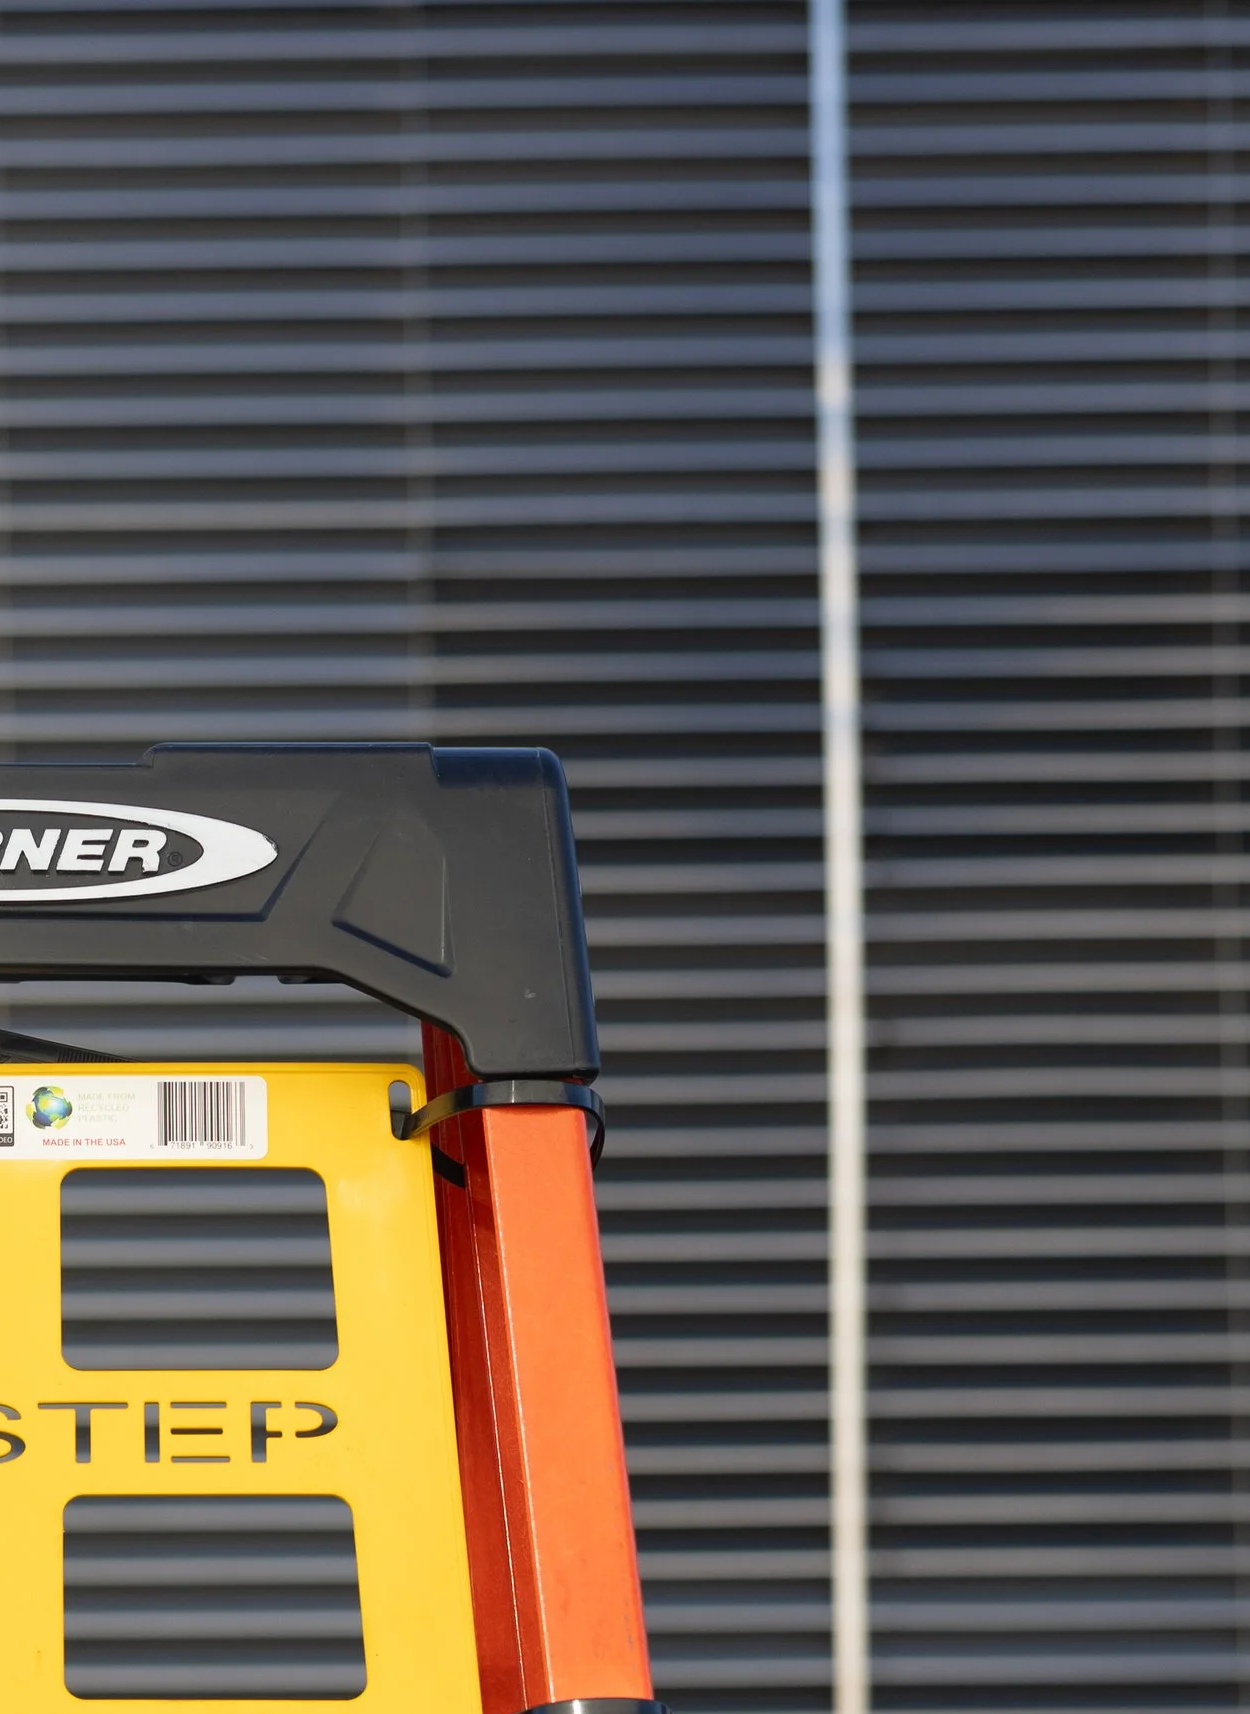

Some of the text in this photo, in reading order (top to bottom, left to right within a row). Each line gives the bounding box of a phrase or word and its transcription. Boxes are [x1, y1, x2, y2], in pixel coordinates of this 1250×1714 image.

[42, 1138, 126, 1146] MADE IN THE USA
[170, 1141, 195, 1150] 71891
[206, 1141, 233, 1150] 90916
